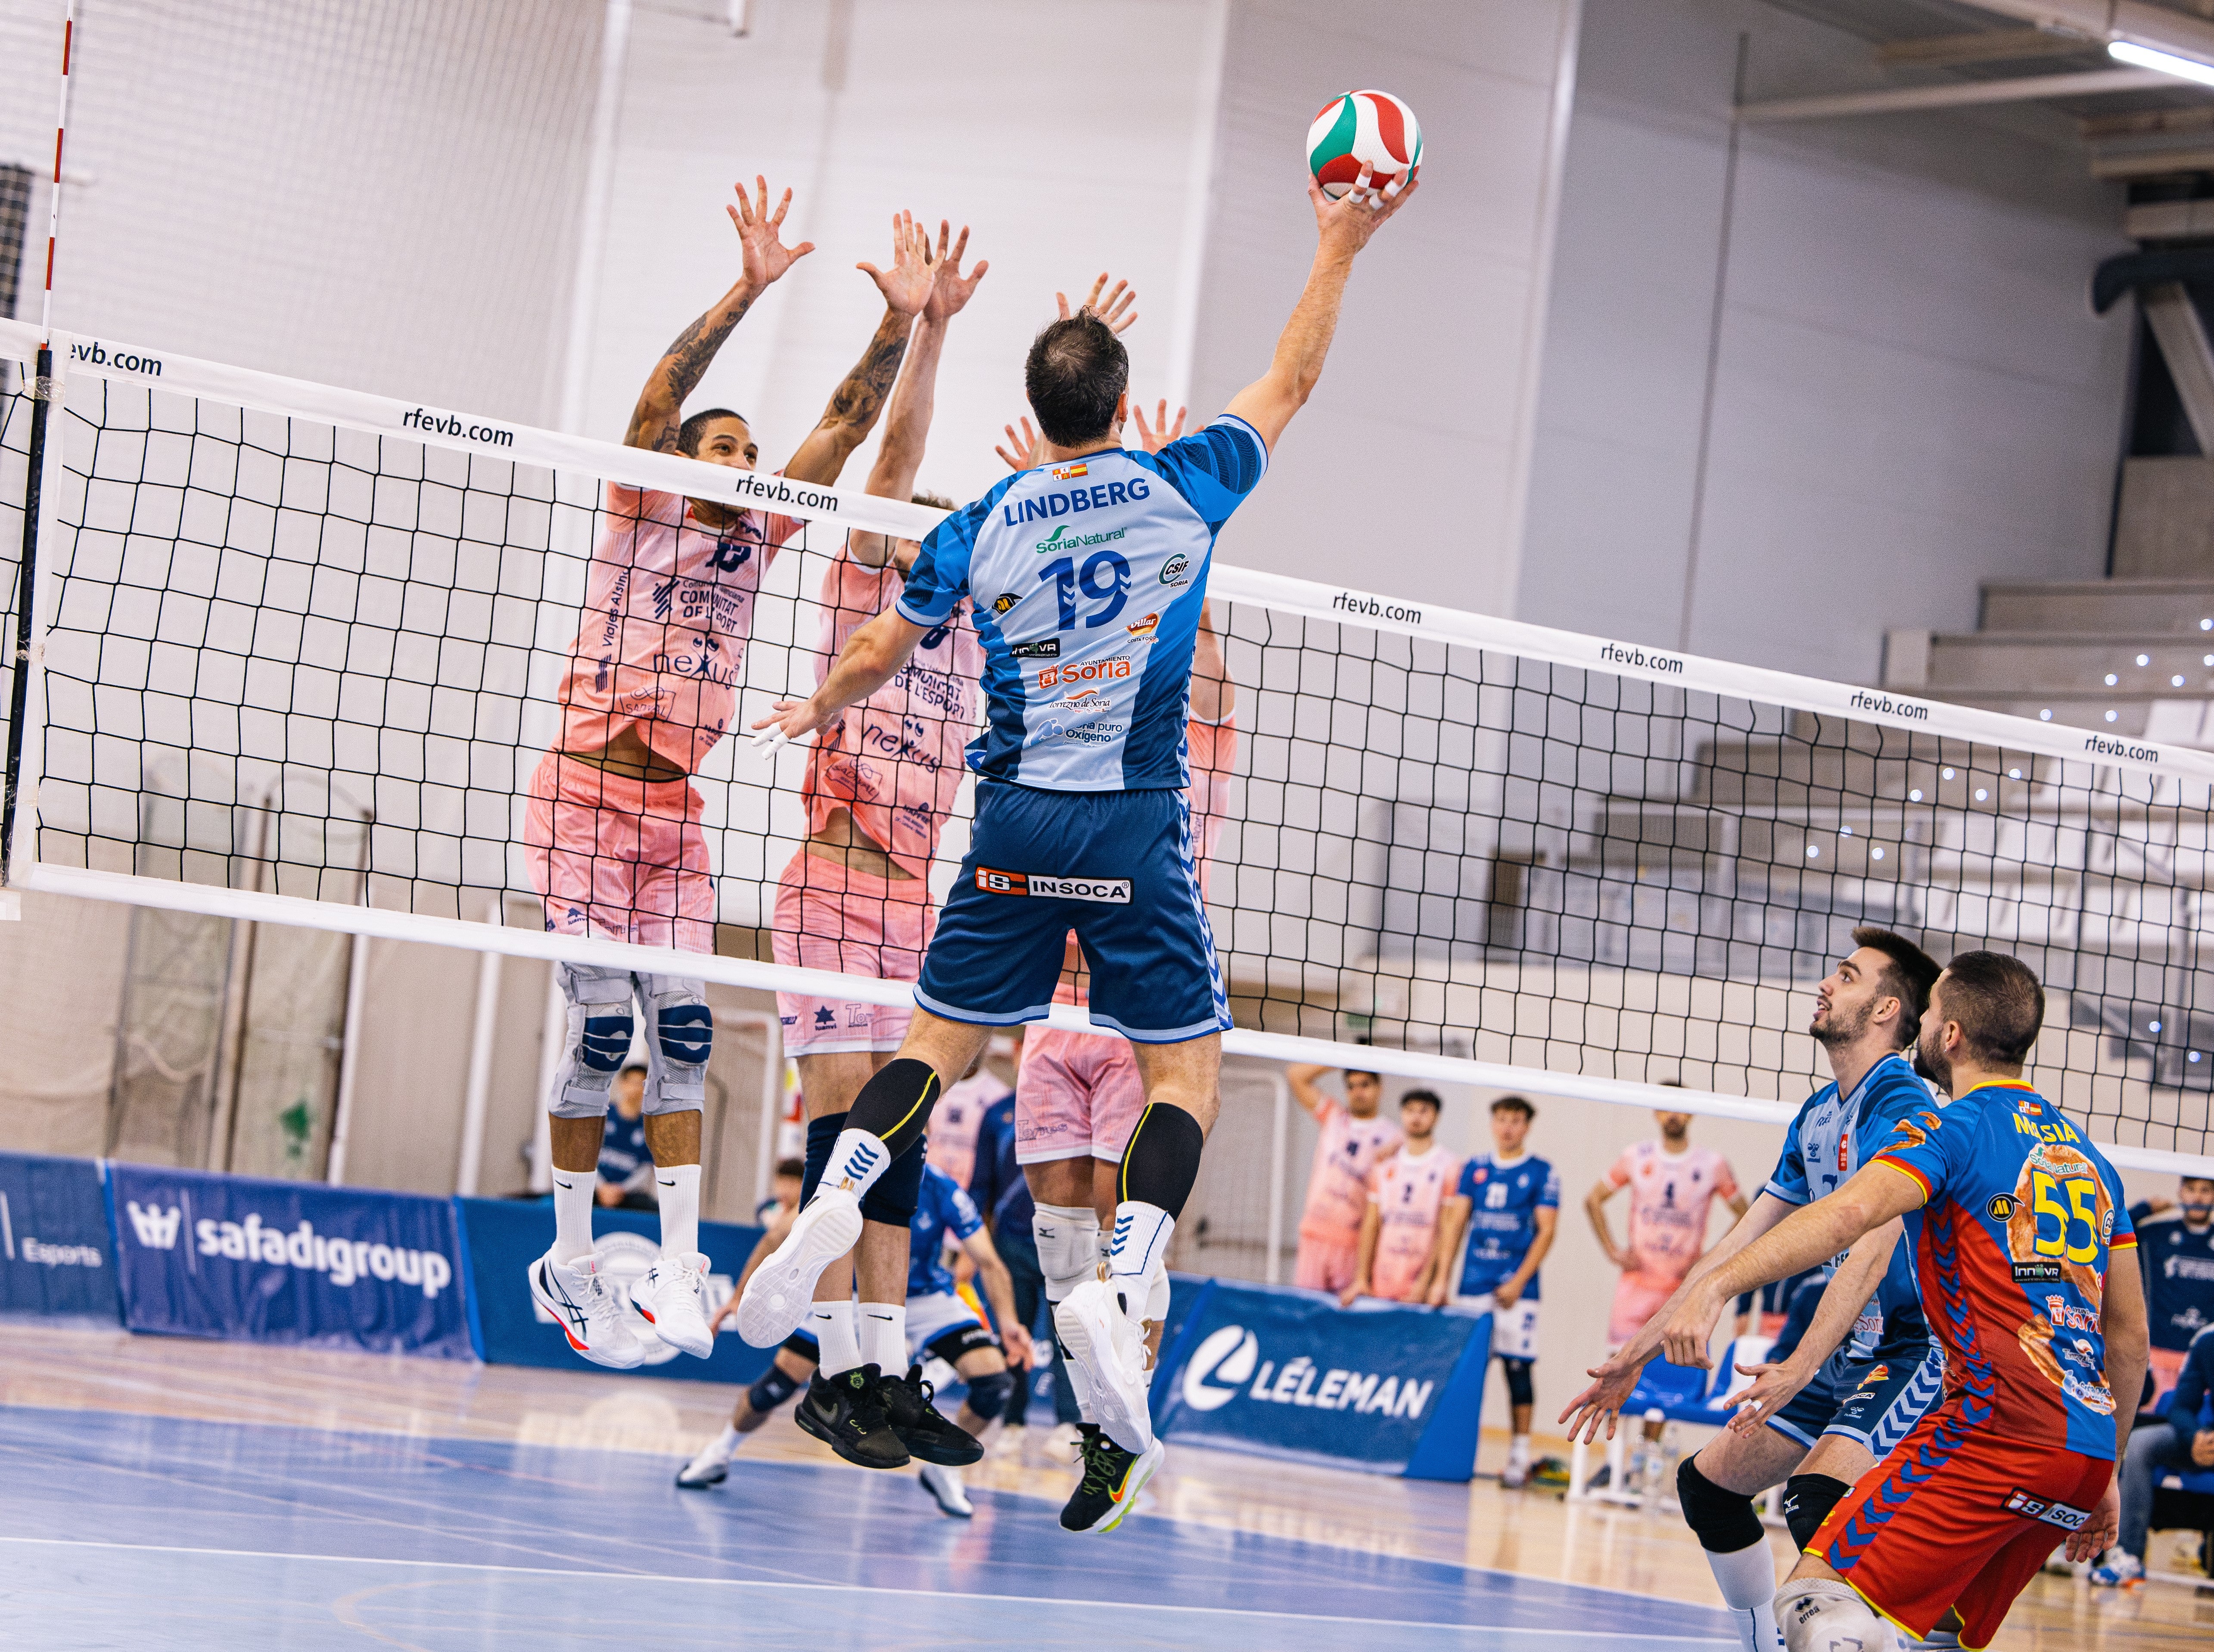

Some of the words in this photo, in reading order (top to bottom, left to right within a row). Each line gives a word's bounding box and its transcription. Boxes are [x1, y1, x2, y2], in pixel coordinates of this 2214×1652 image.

[403, 408, 513, 447] rfevb.com
[736, 475, 838, 512] rfevb.com
[1004, 478, 1150, 526] LINDBERG
[1165, 561, 1189, 575] CSIF
[1038, 550, 1132, 631] 19
[1169, 580, 1188, 588] SORIA
[1333, 593, 1421, 624] rfevb.com
[603, 608, 618, 646] Viajes
[1062, 661, 1130, 683] Soria
[1080, 656, 1130, 666] AYUNTAMIENTO
[1601, 644, 1683, 673] rfevb.com
[1081, 697, 1089, 708] de
[1090, 698, 1110, 707] Soria
[1851, 691, 1928, 720] rfevb.com
[1066, 729, 1111, 743] Oxígeno
[1097, 723, 1123, 733] puro
[2086, 736, 2158, 762] rfevb.com
[2032, 1171, 2098, 1263] 55
[22, 1237, 103, 1269] Esports
[1250, 1356, 1434, 1420] LÉLEMAN
